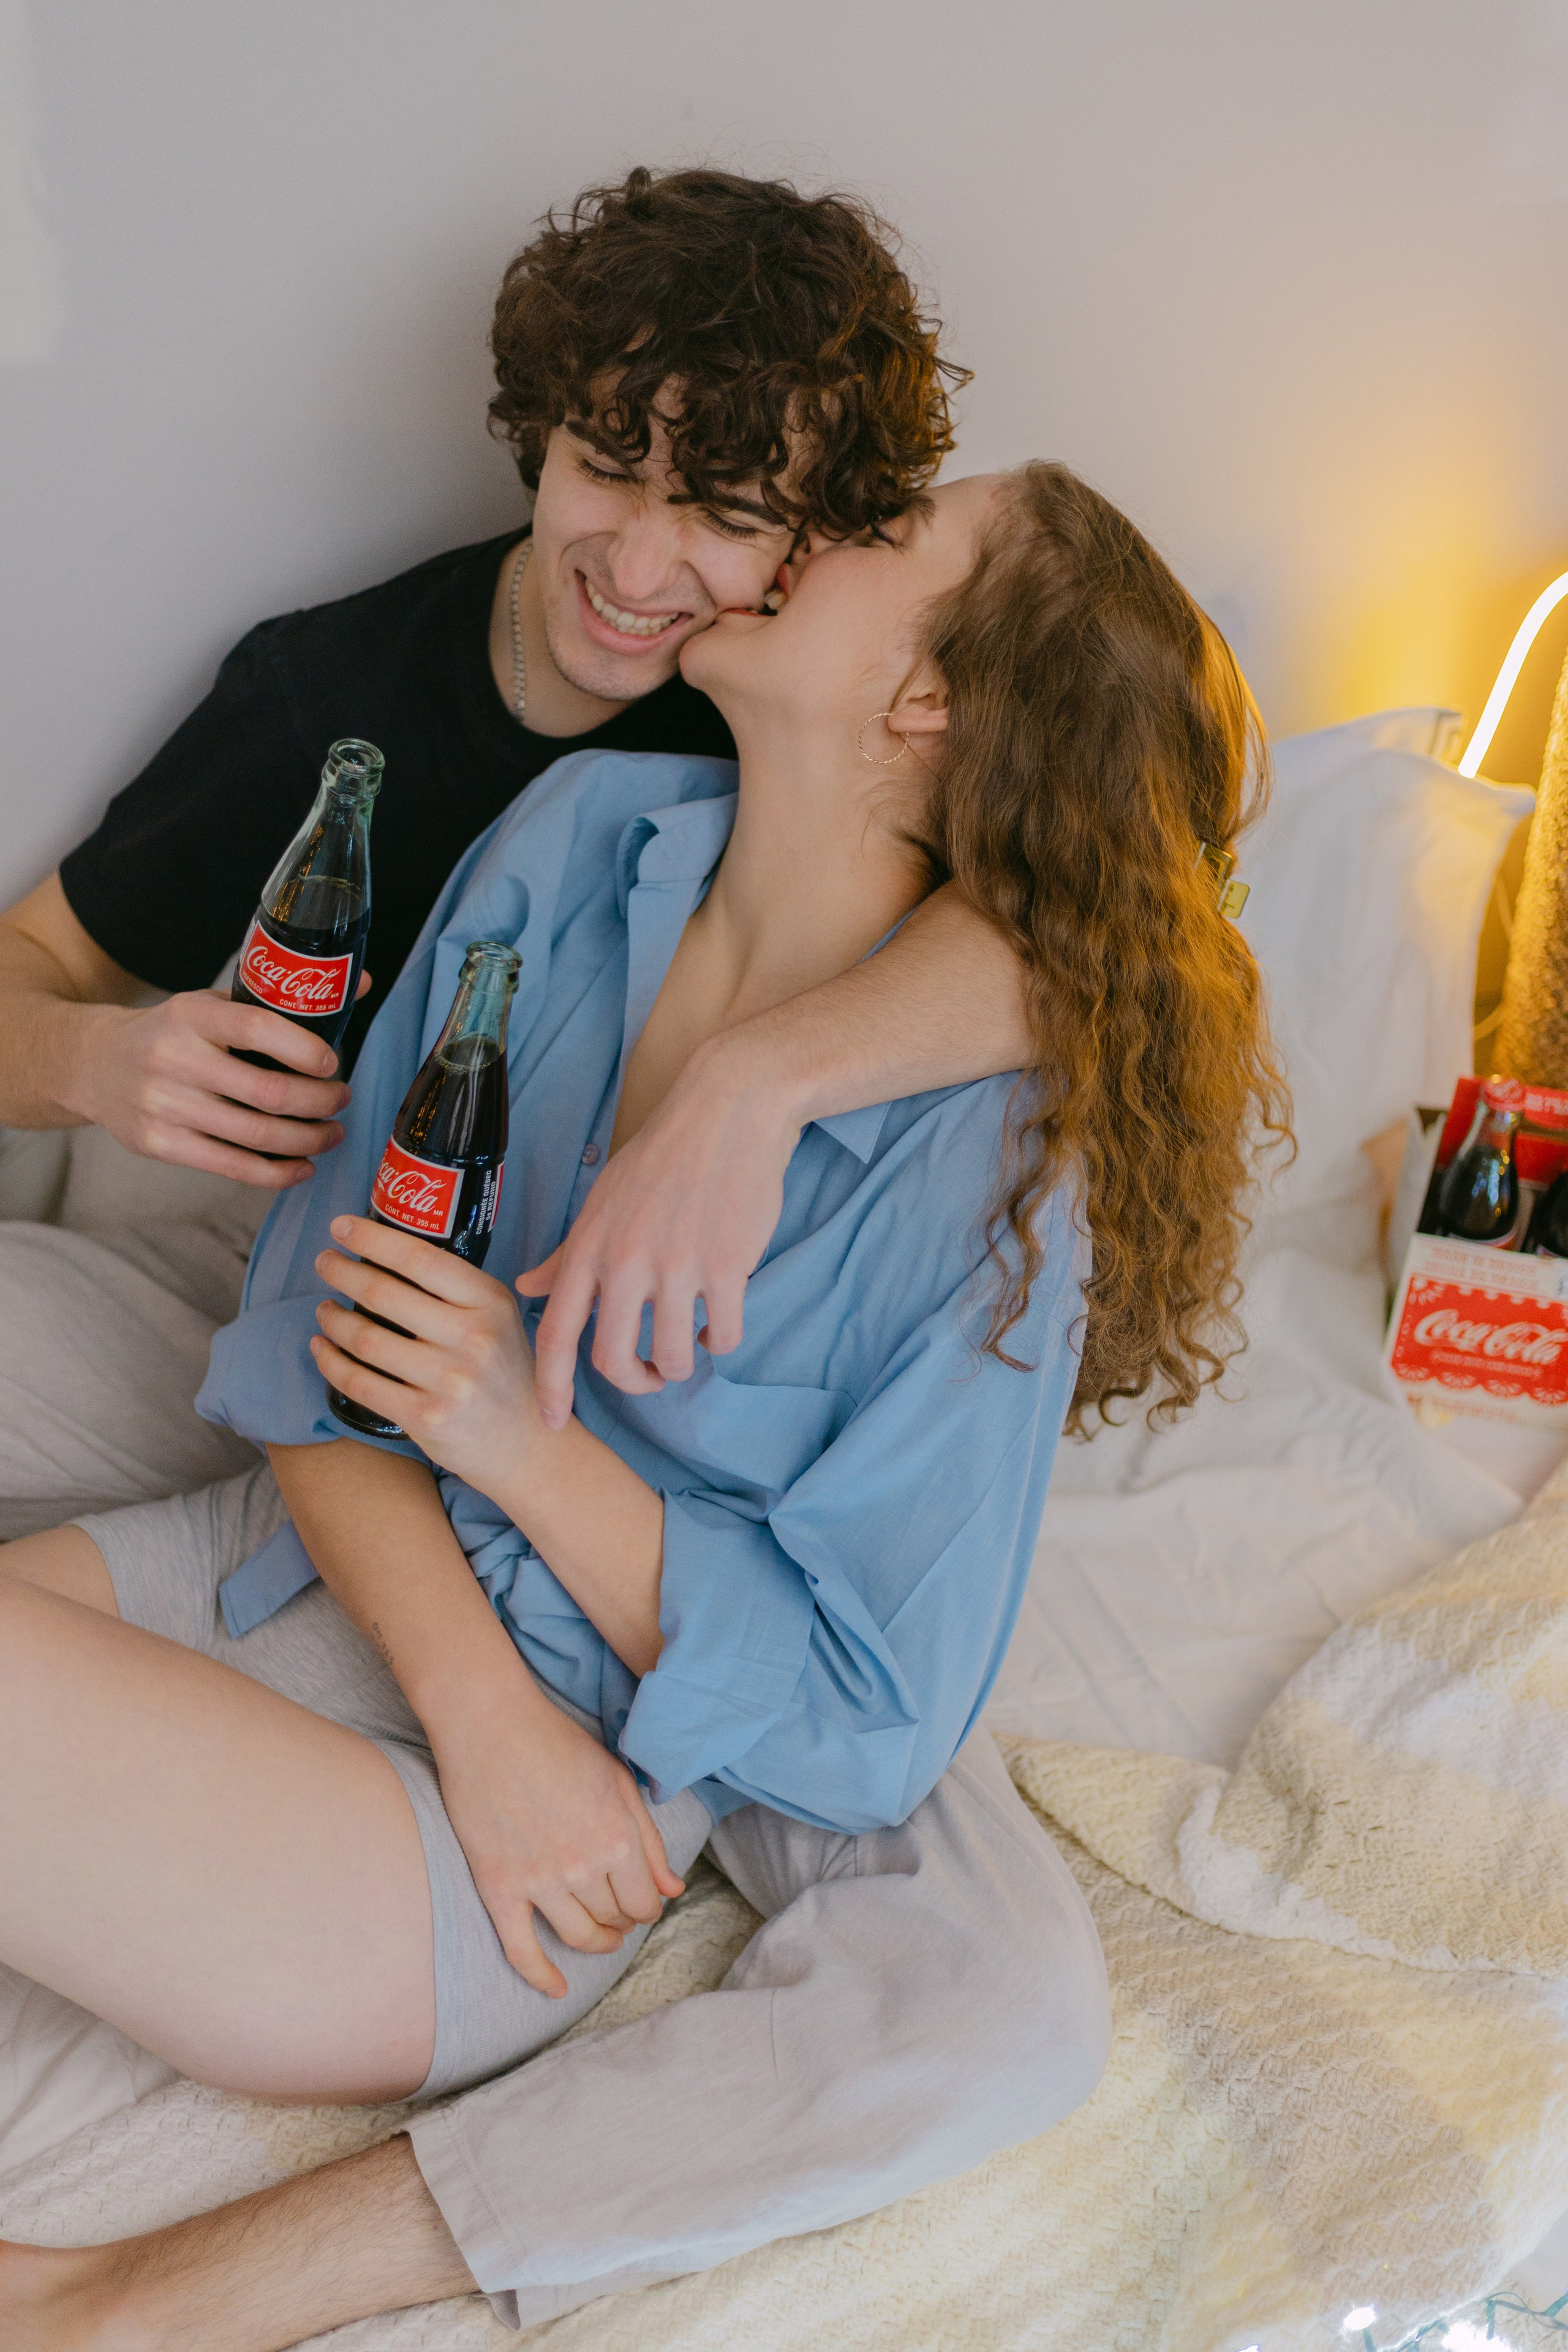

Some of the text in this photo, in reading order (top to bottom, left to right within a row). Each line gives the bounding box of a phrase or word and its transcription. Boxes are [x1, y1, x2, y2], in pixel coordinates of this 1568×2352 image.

[247, 946, 342, 1000] Coca-Cola
[377, 1148, 447, 1213] ca-Cola
[476, 1170, 492, 1235] CONSIGNÉE QUÉBEC
[488, 1181, 496, 1210] REFUND
[401, 1213, 415, 1224] NET.
[417, 1218, 429, 1227] 355
